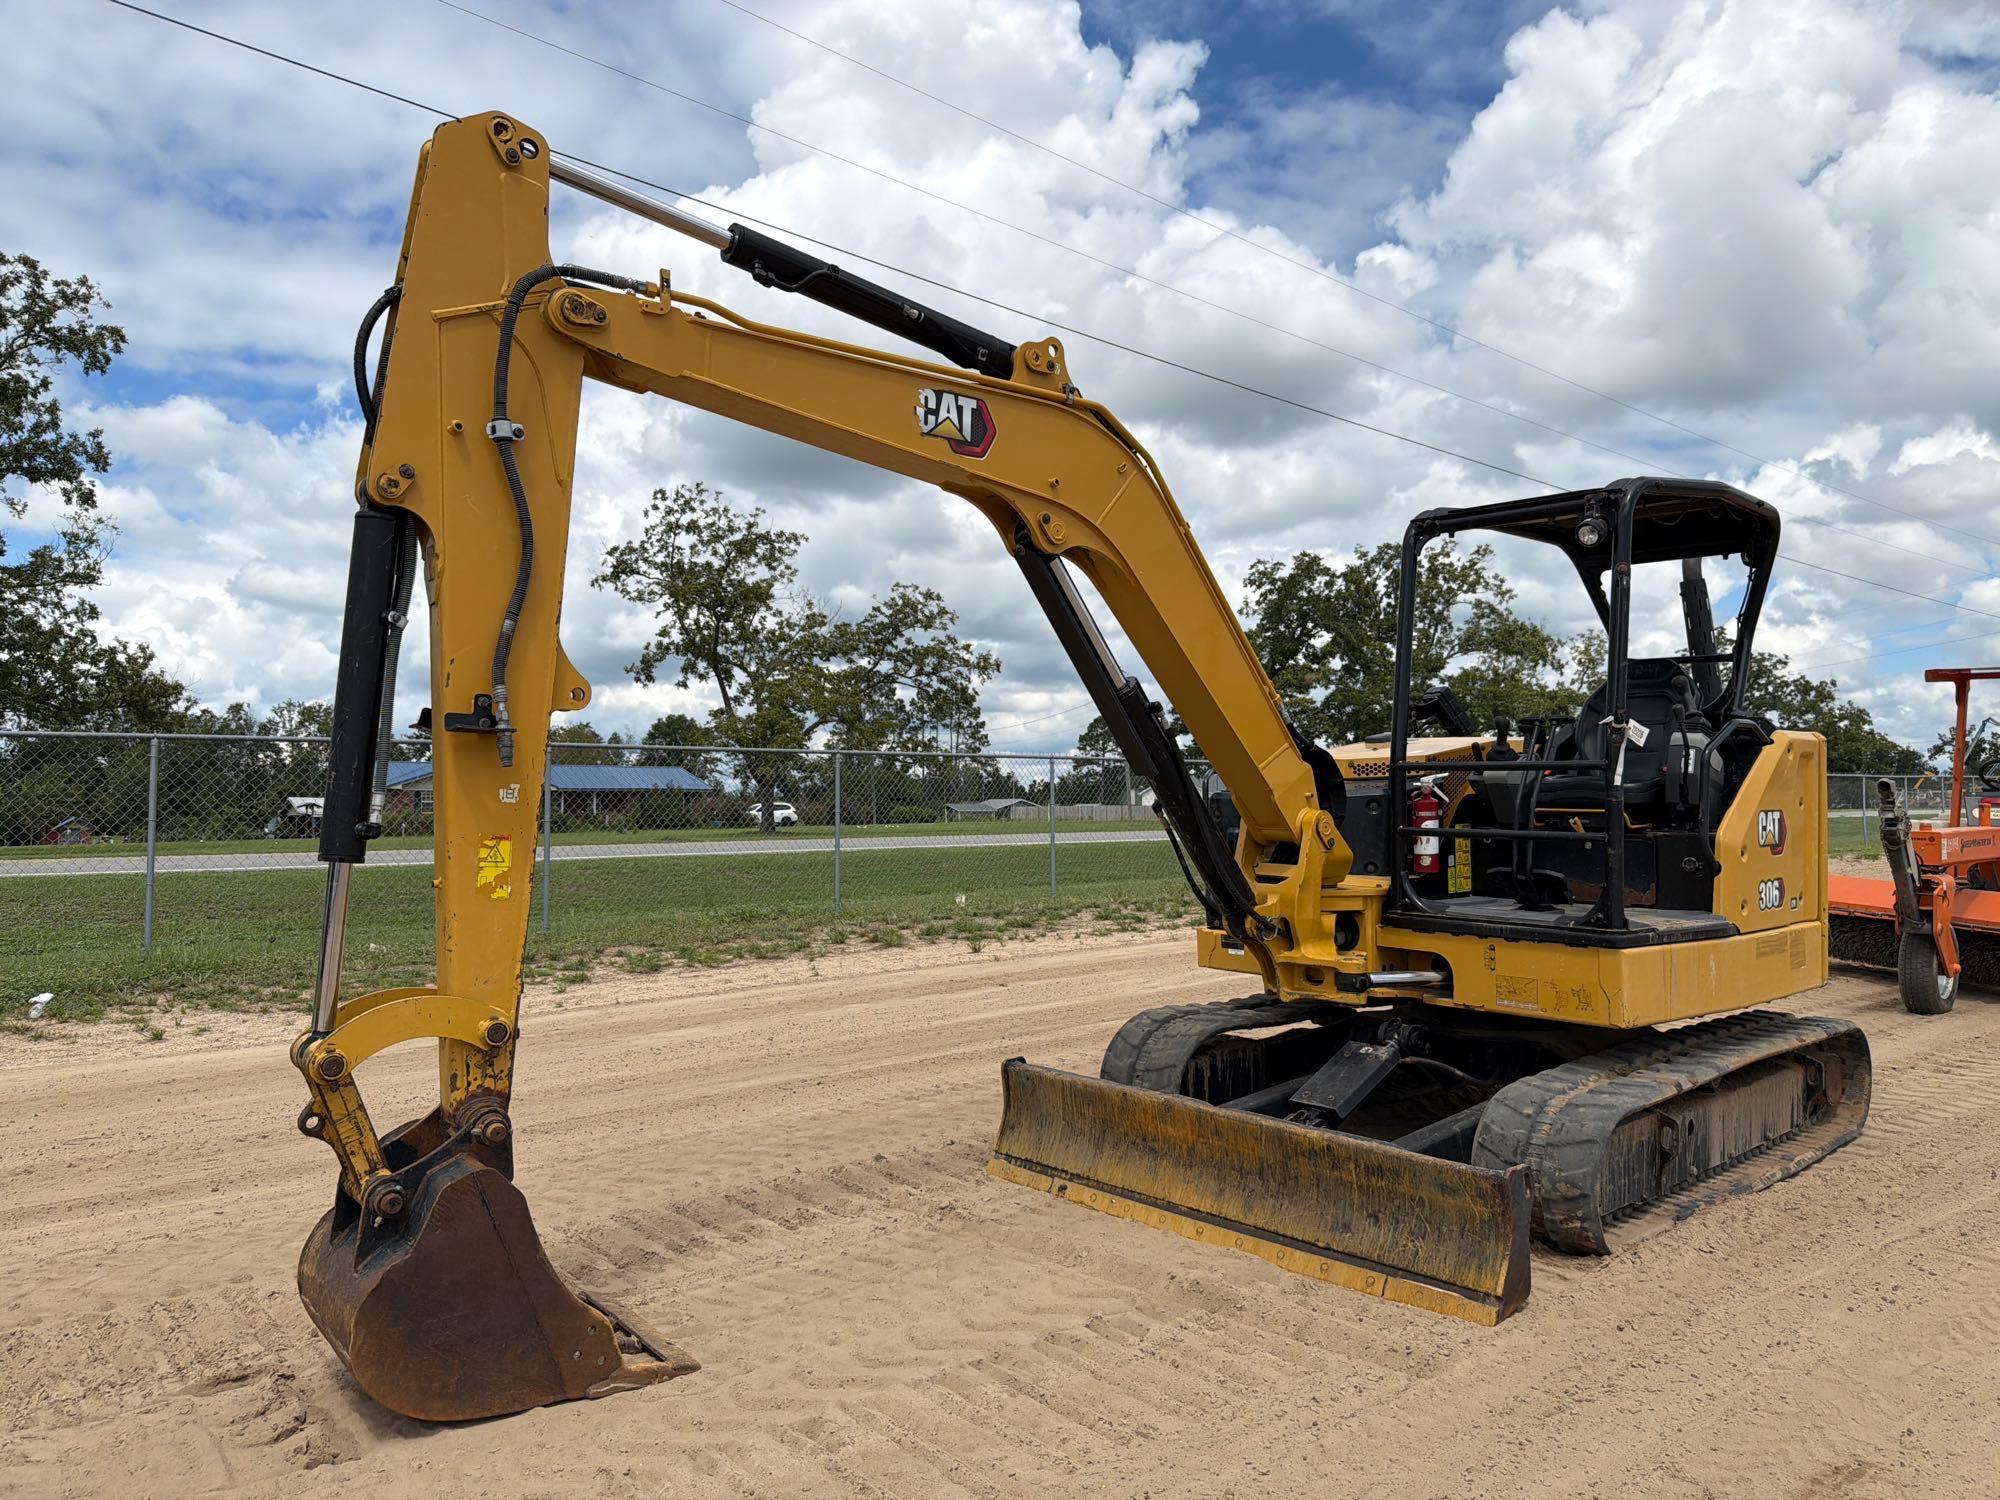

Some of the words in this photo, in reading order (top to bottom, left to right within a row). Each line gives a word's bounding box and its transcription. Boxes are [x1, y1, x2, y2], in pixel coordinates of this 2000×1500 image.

[916, 388, 978, 442] CAT
[1758, 811, 1780, 846] CAT
[1759, 880, 1780, 910] 306
